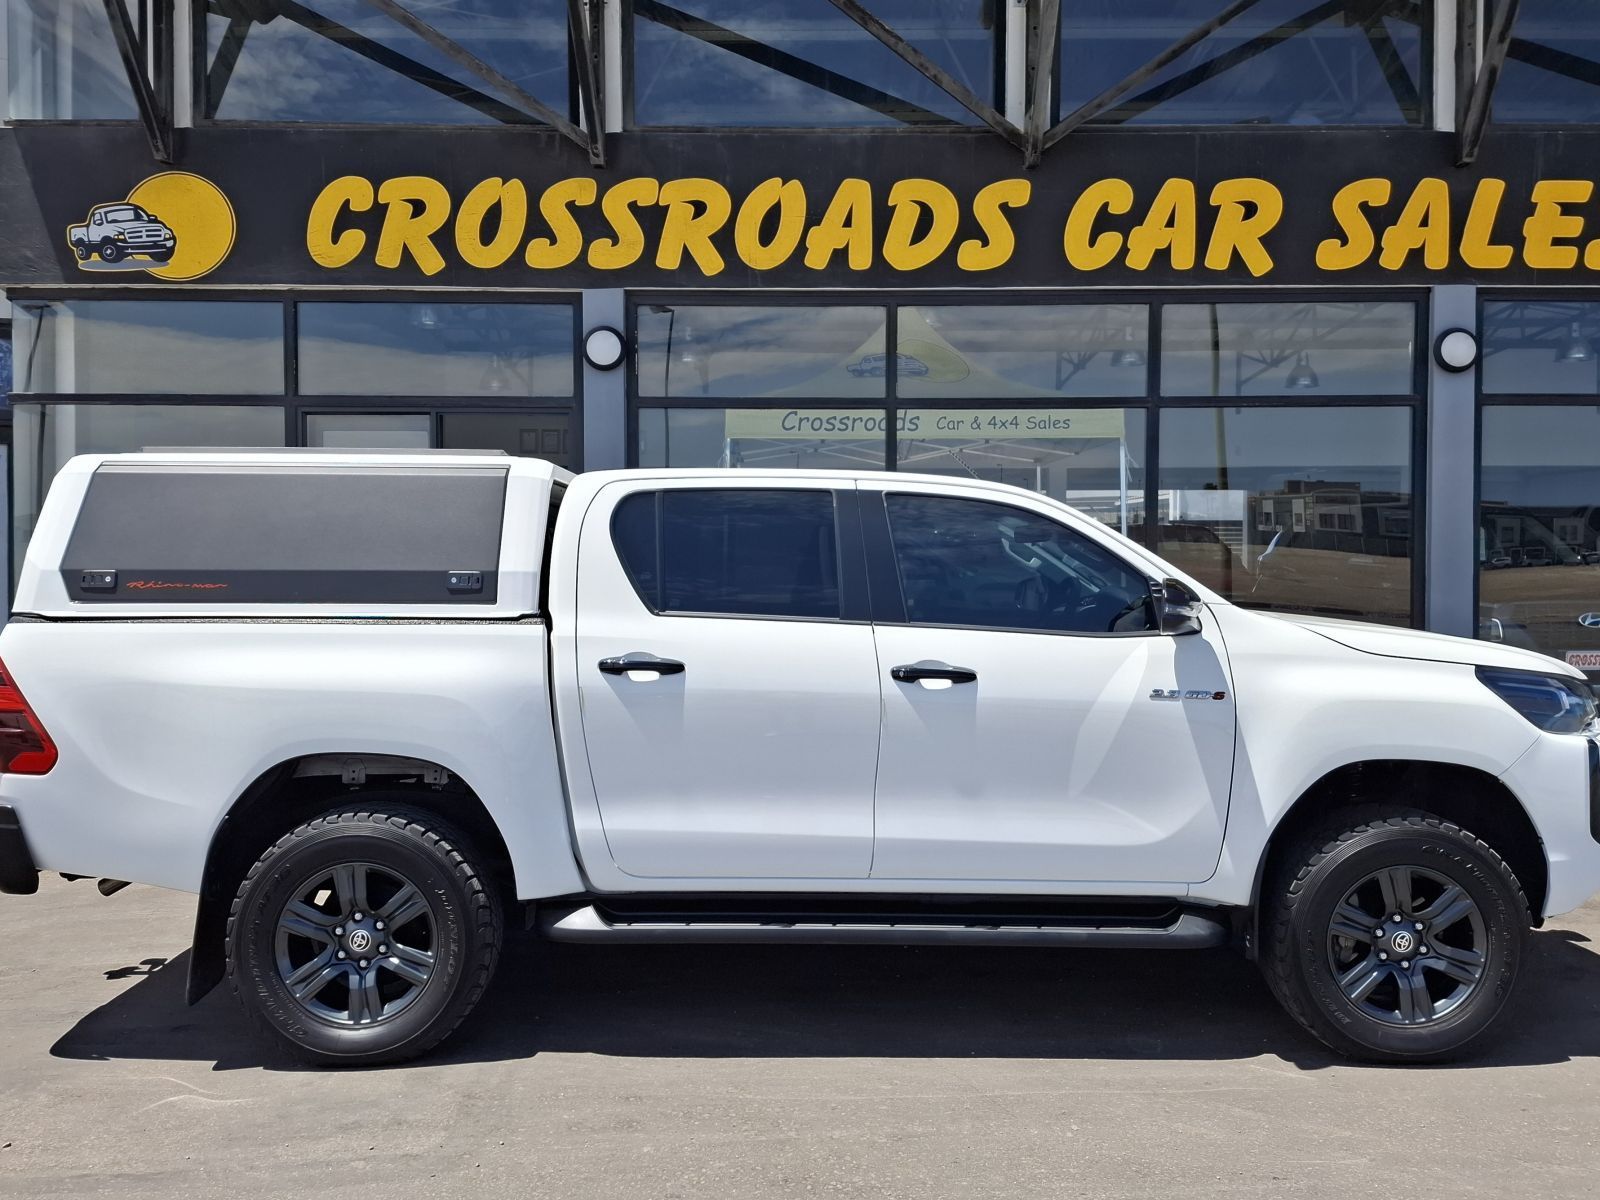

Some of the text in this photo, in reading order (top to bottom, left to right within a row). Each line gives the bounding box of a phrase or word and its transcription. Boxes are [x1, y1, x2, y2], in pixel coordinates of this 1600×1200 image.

[307, 176, 1600, 276] CROSSROADS CAR SALE
[936, 416, 965, 431] Car
[970, 415, 982, 430] &
[987, 415, 1020, 430] 4x4
[1025, 414, 1071, 430] Sales
[1568, 654, 1600, 667] CROSS
